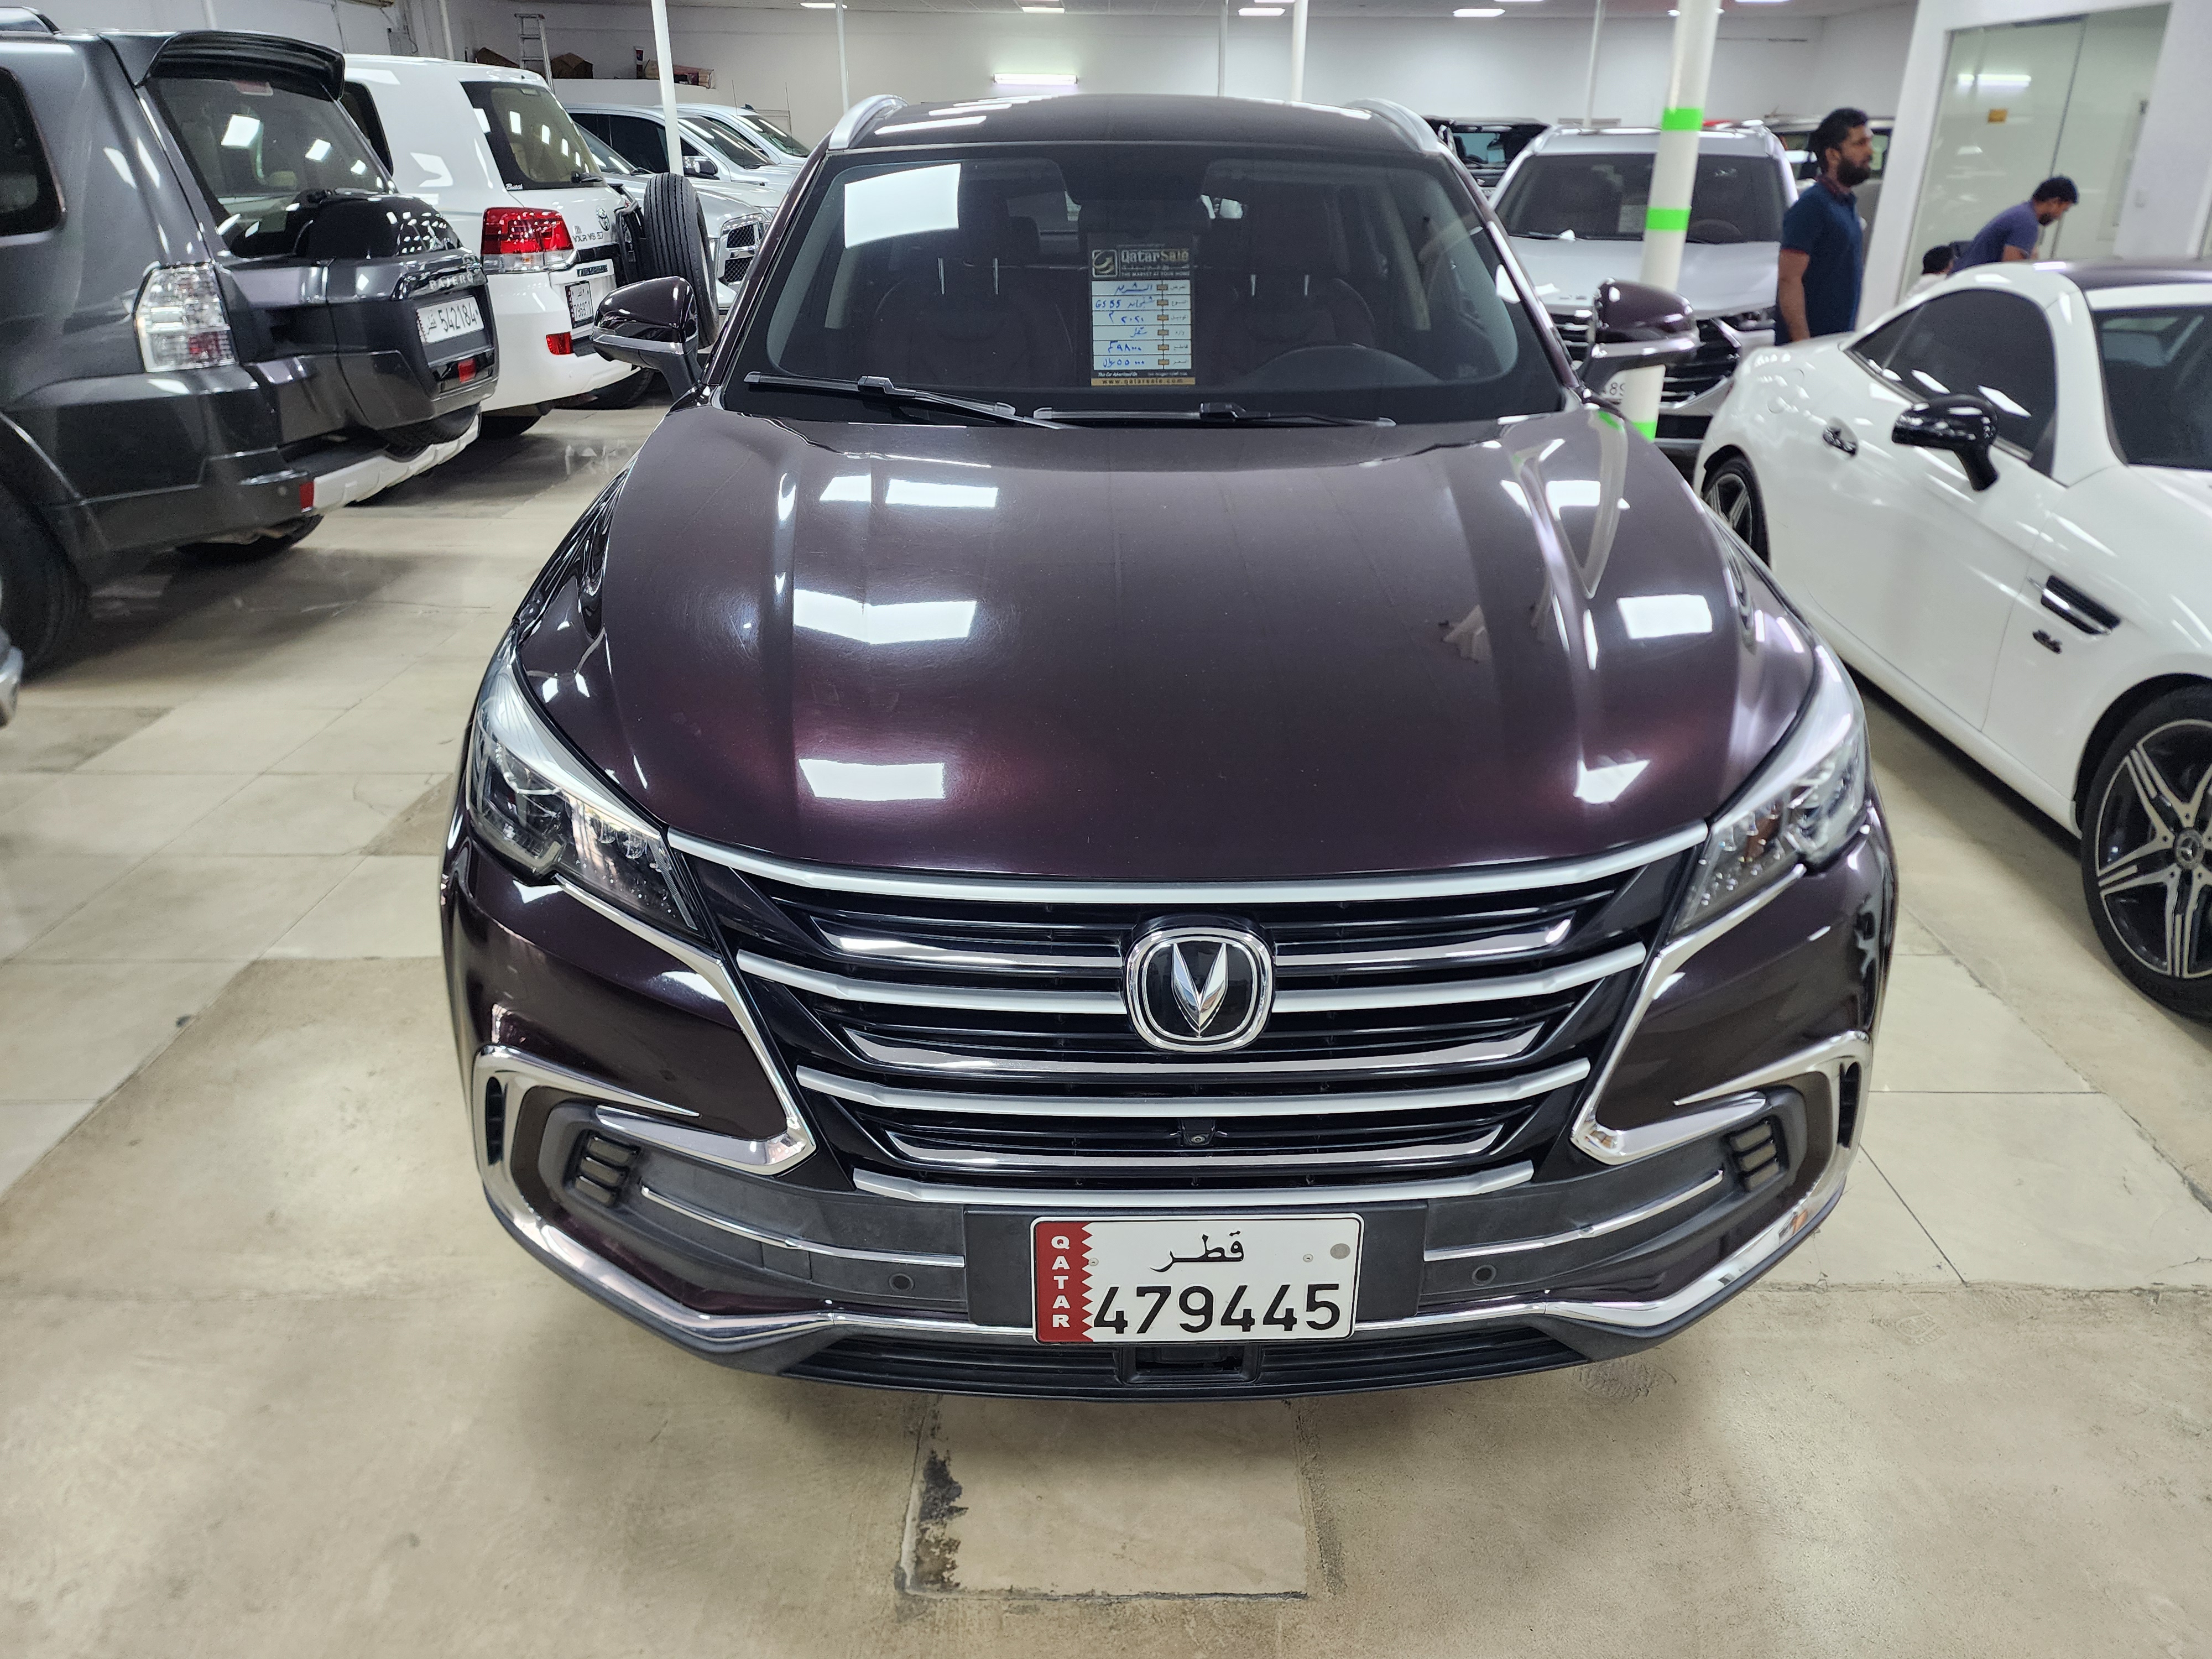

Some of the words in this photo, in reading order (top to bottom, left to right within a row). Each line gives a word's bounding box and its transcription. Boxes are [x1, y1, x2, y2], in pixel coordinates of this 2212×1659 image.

[429, 274, 474, 290] PAJERO
[438, 302, 477, 332] 542184
[1149, 1230, 1245, 1272] قطر
[1051, 1235, 1071, 1328] QATAR
[1093, 1284, 1340, 1334] 479445
